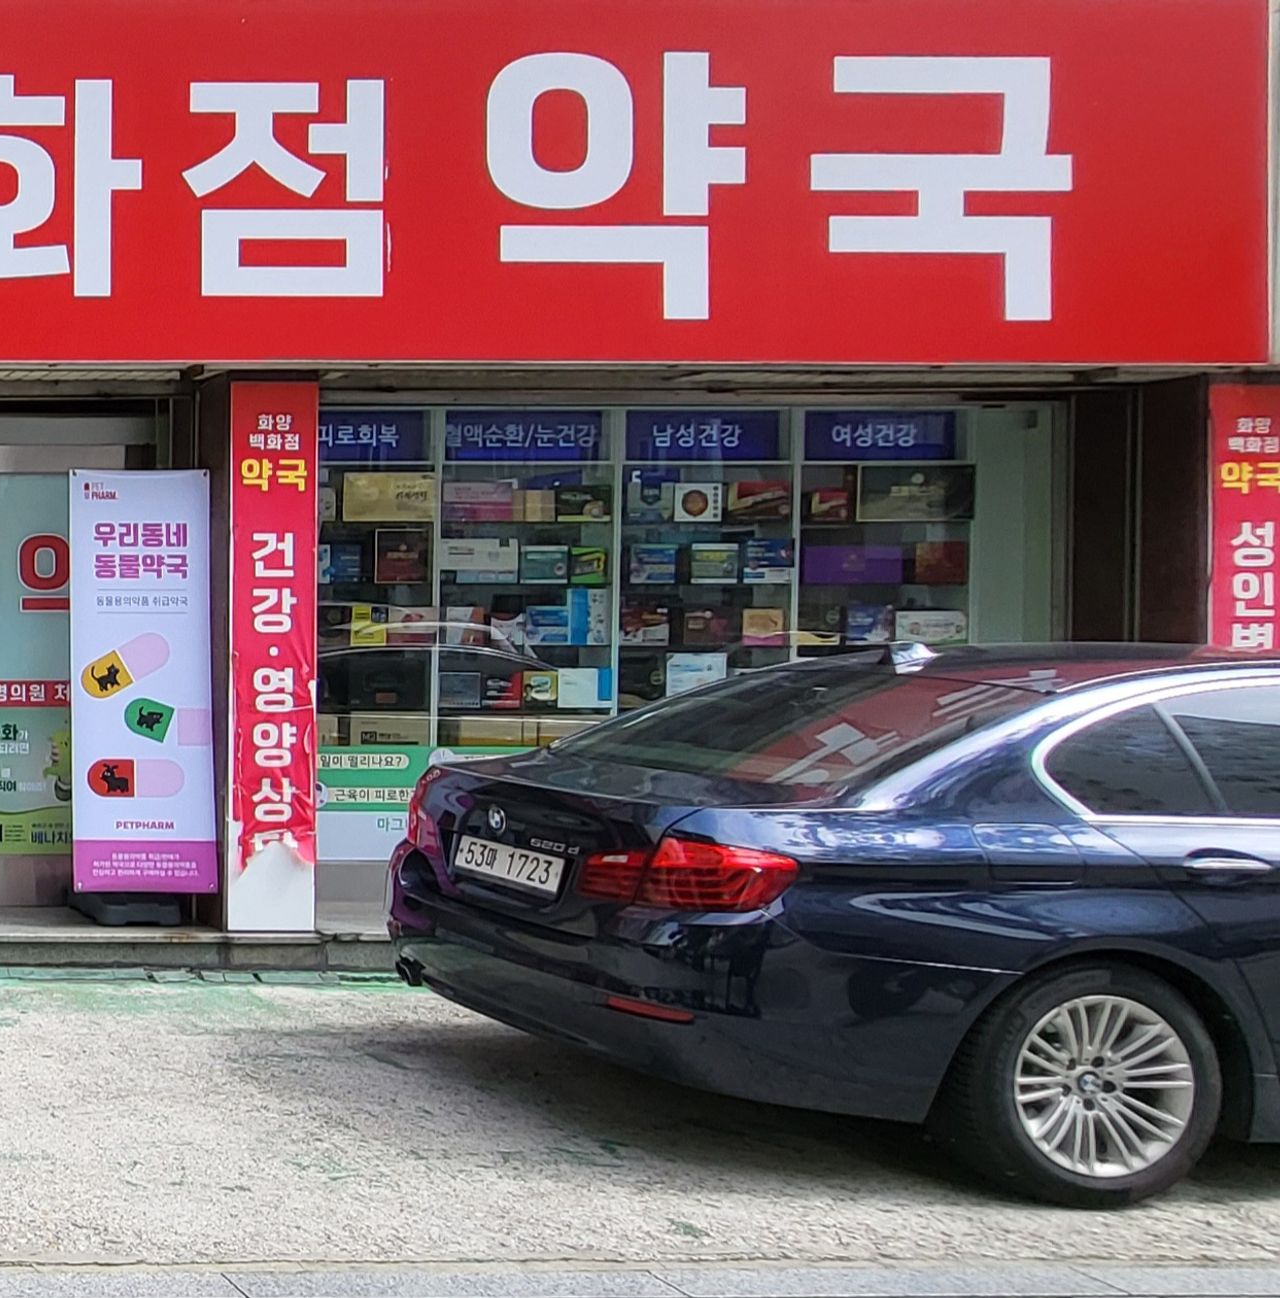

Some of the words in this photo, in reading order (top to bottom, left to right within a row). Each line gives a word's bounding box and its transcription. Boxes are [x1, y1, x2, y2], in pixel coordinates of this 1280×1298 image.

[486, 51, 1072, 321] 약국
[257, 414, 292, 430] 화양
[1237, 417, 1271, 434] 화양
[249, 433, 301, 451] 백화점
[318, 423, 400, 447] 피로회복
[652, 423, 742, 448] 남성건강
[831, 423, 918, 448] 여성건강
[1228, 437, 1280, 454] 백화점
[241, 457, 308, 491] 약국
[1221, 462, 1280, 495] 약국
[94, 523, 188, 547] 우리동네
[94, 554, 188, 579] 동물약국
[348, 755, 402, 768] 떨리나요?
[335, 789, 370, 801] 근육이
[116, 821, 175, 830] PETPHARM
[464, 841, 498, 871] 53마
[506, 851, 554, 885] 1723
